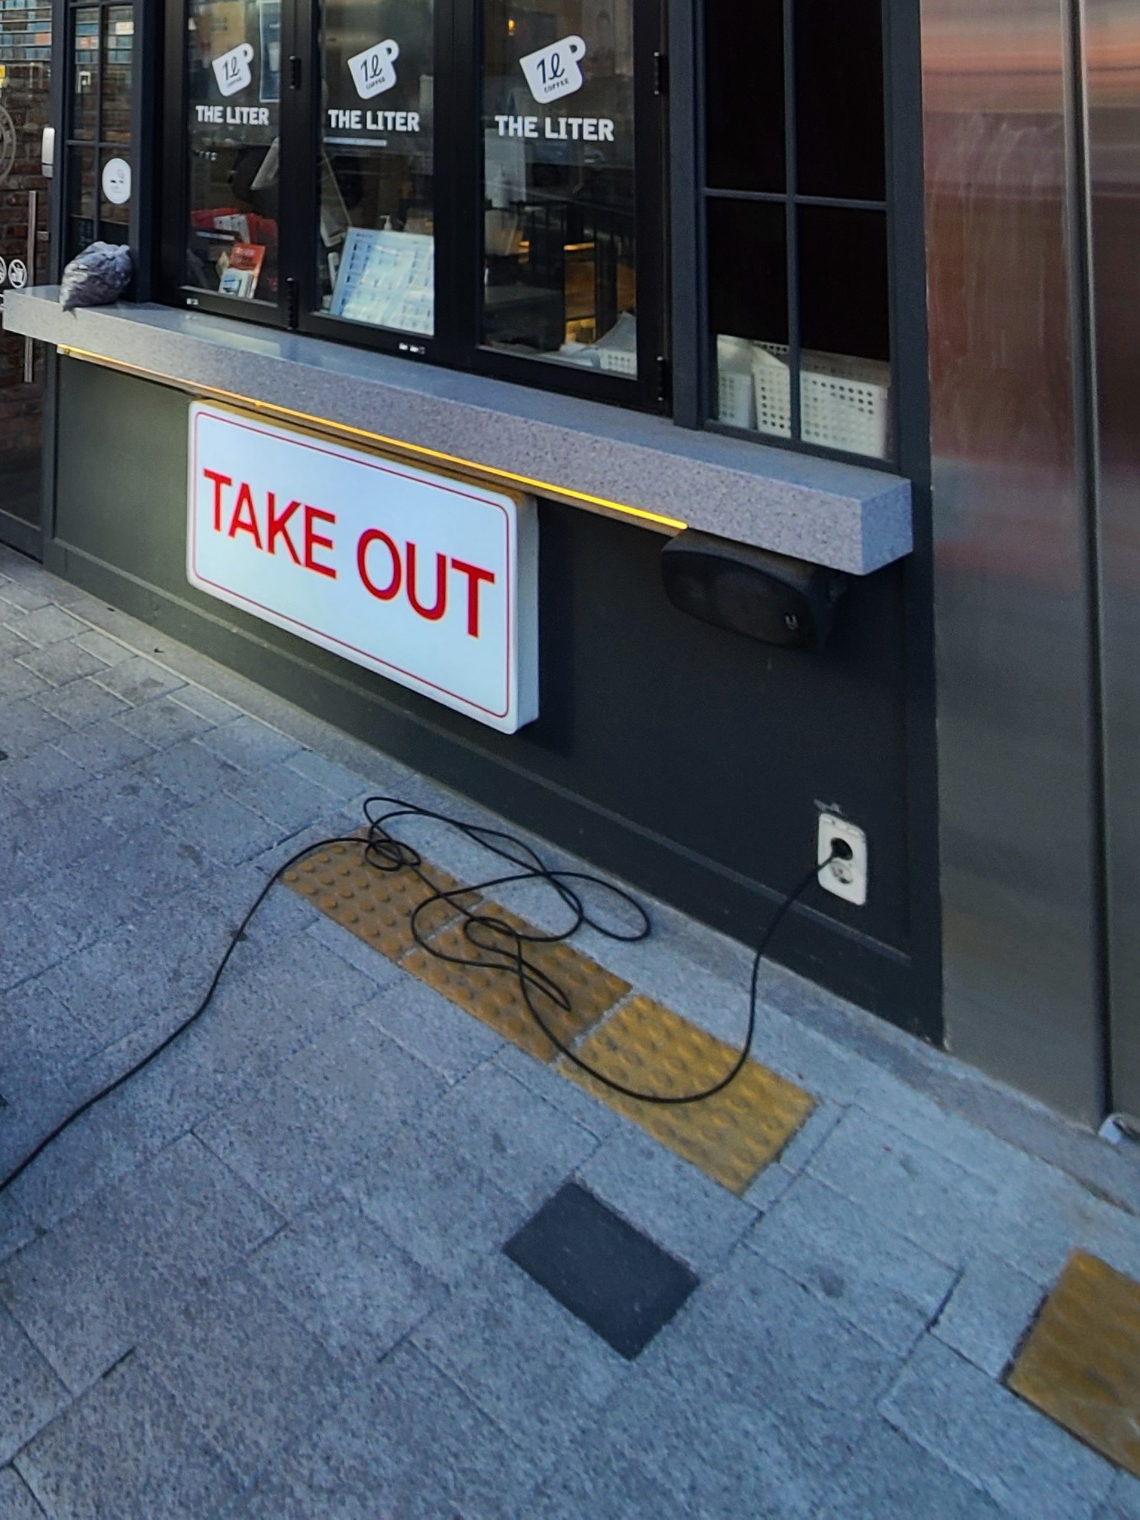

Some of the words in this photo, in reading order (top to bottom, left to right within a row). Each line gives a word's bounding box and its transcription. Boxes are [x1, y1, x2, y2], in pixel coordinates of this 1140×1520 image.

[195, 105, 224, 123] THE
[226, 106, 269, 126] LITER
[328, 109, 362, 129] THE
[366, 110, 420, 132] LITER
[494, 115, 539, 138] THE
[544, 116, 614, 142] LITER
[203, 469, 339, 580] TAKE
[356, 527, 497, 641] OUT
